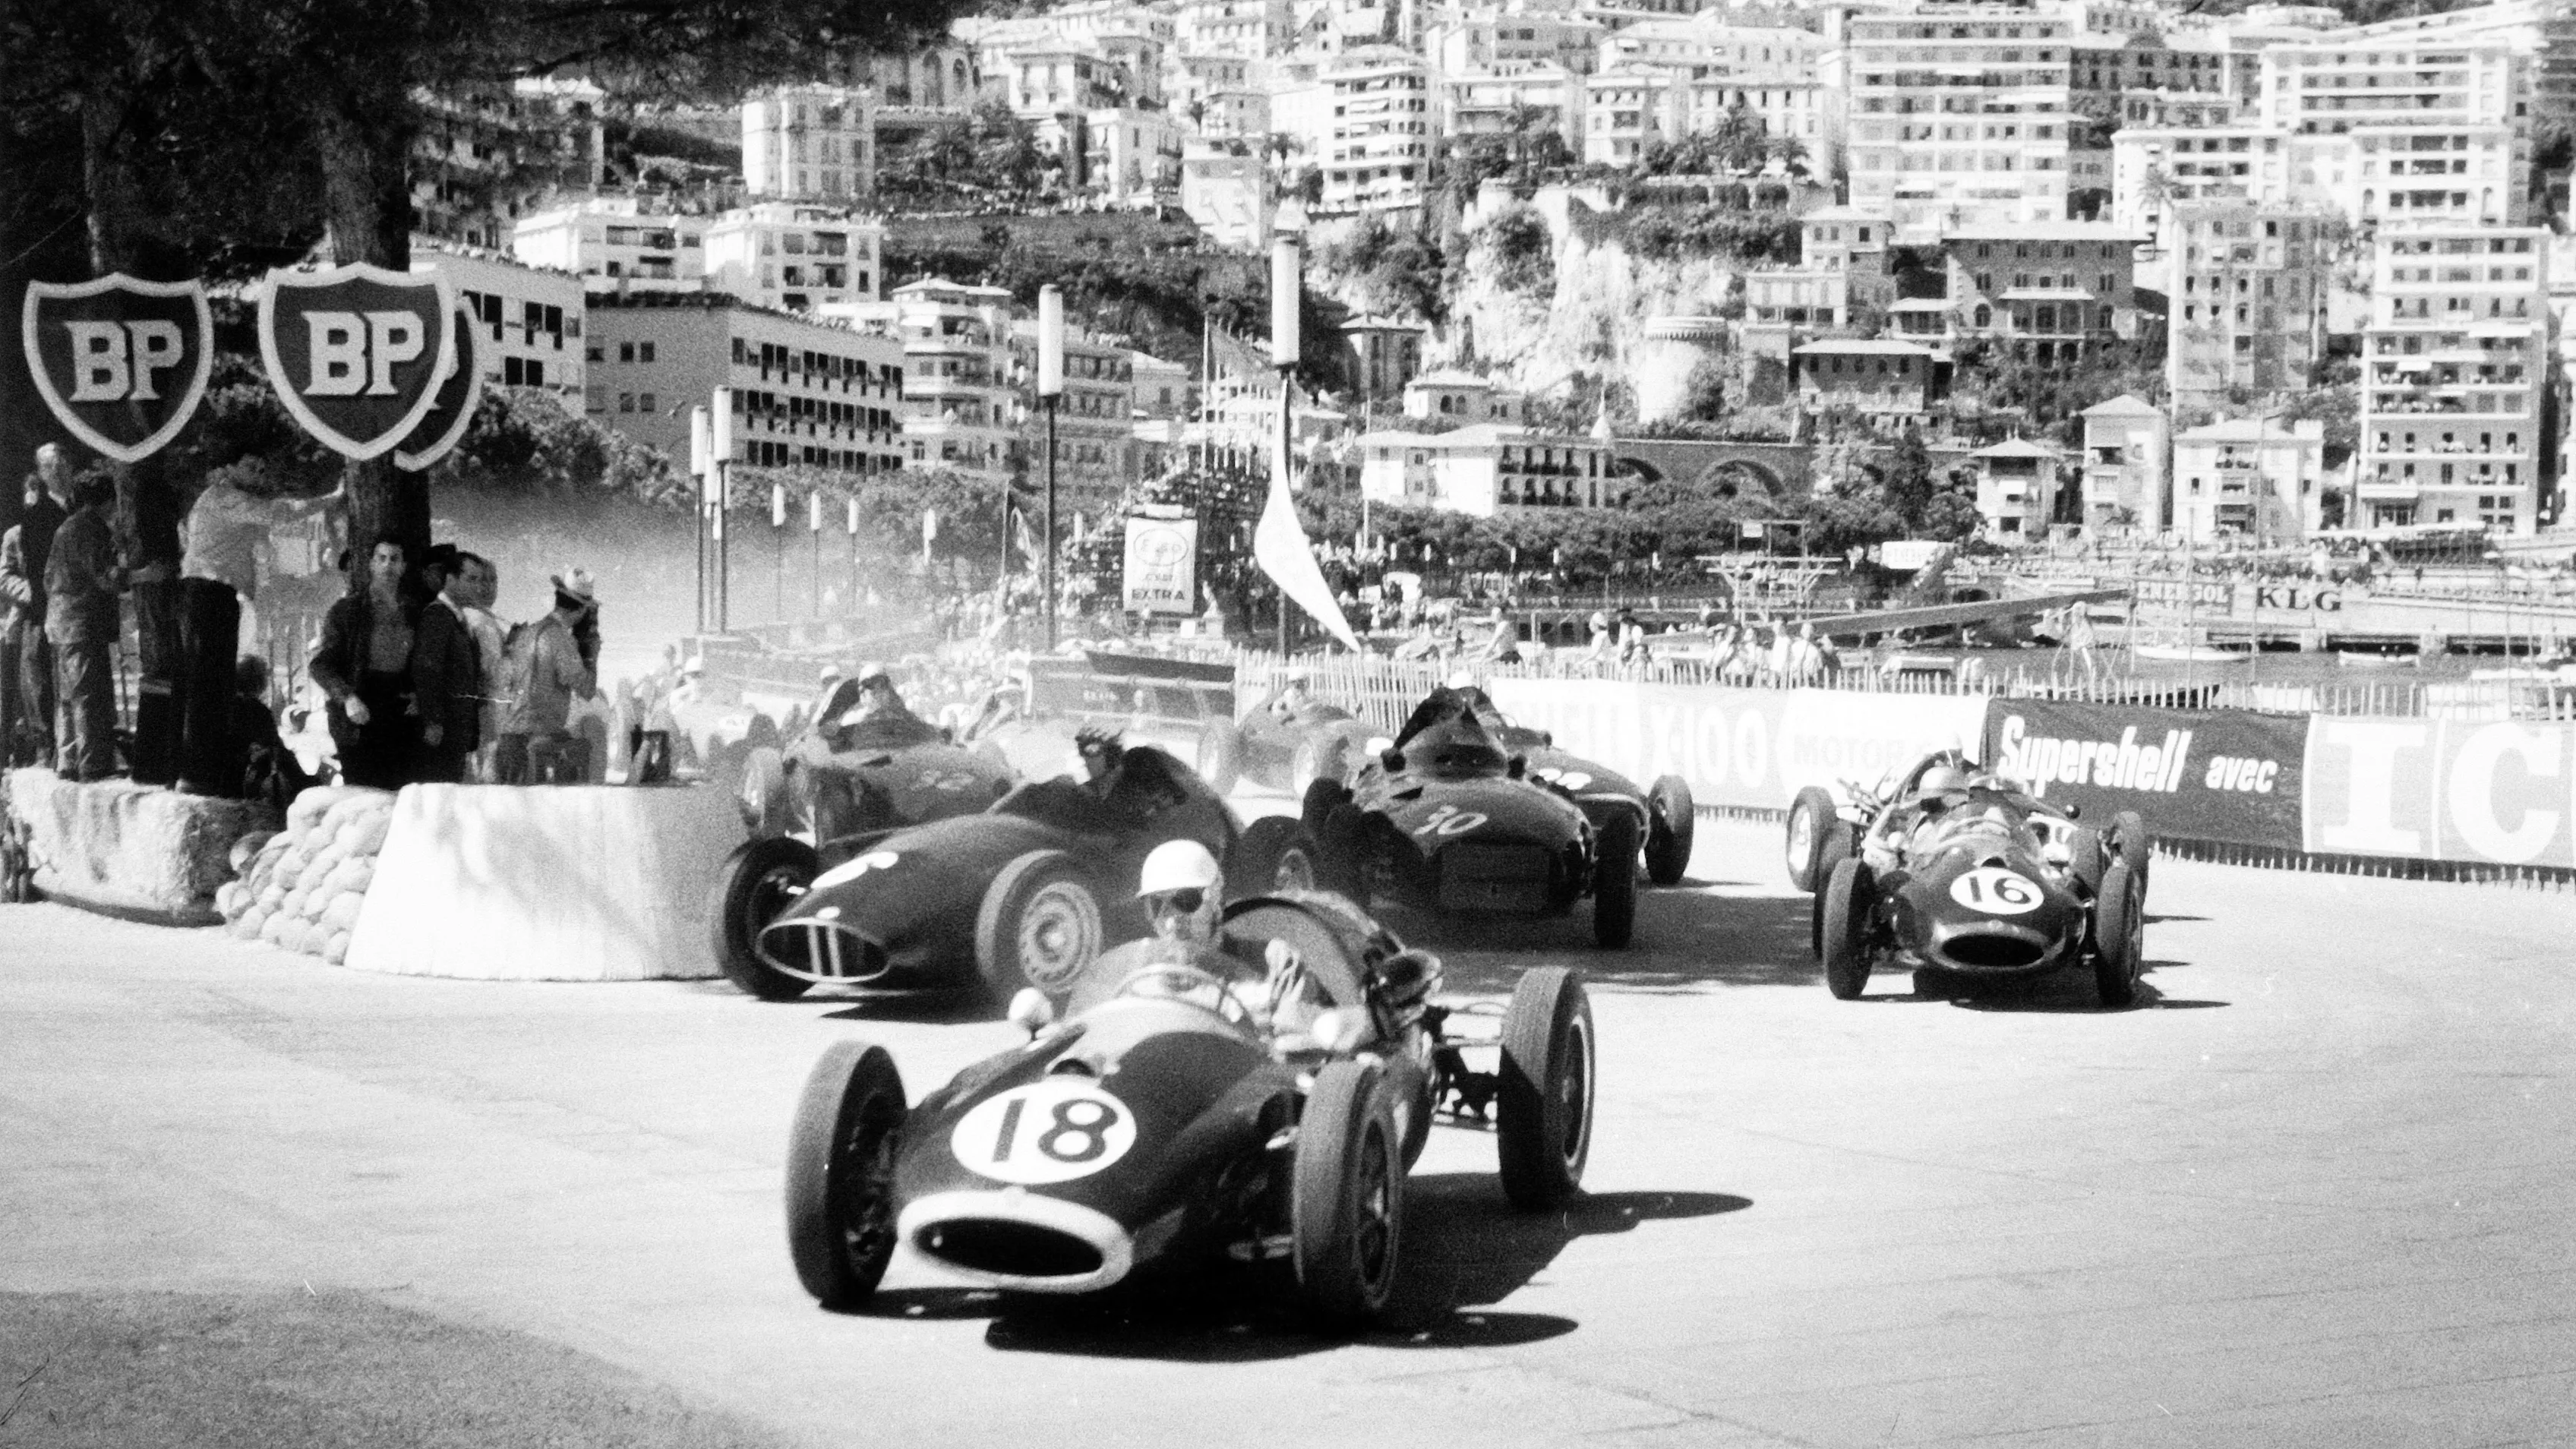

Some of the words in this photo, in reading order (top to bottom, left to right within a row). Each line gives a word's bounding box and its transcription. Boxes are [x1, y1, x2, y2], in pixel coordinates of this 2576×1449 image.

[64, 319, 184, 401] BP
[300, 310, 425, 396] BP
[1132, 589, 1185, 600] EXTRA
[1997, 715, 2192, 798] Supershell
[2205, 756, 2278, 794] avec
[1414, 805, 1488, 835] 30
[1968, 876, 2031, 904] 16
[992, 1098, 1119, 1163] 18
